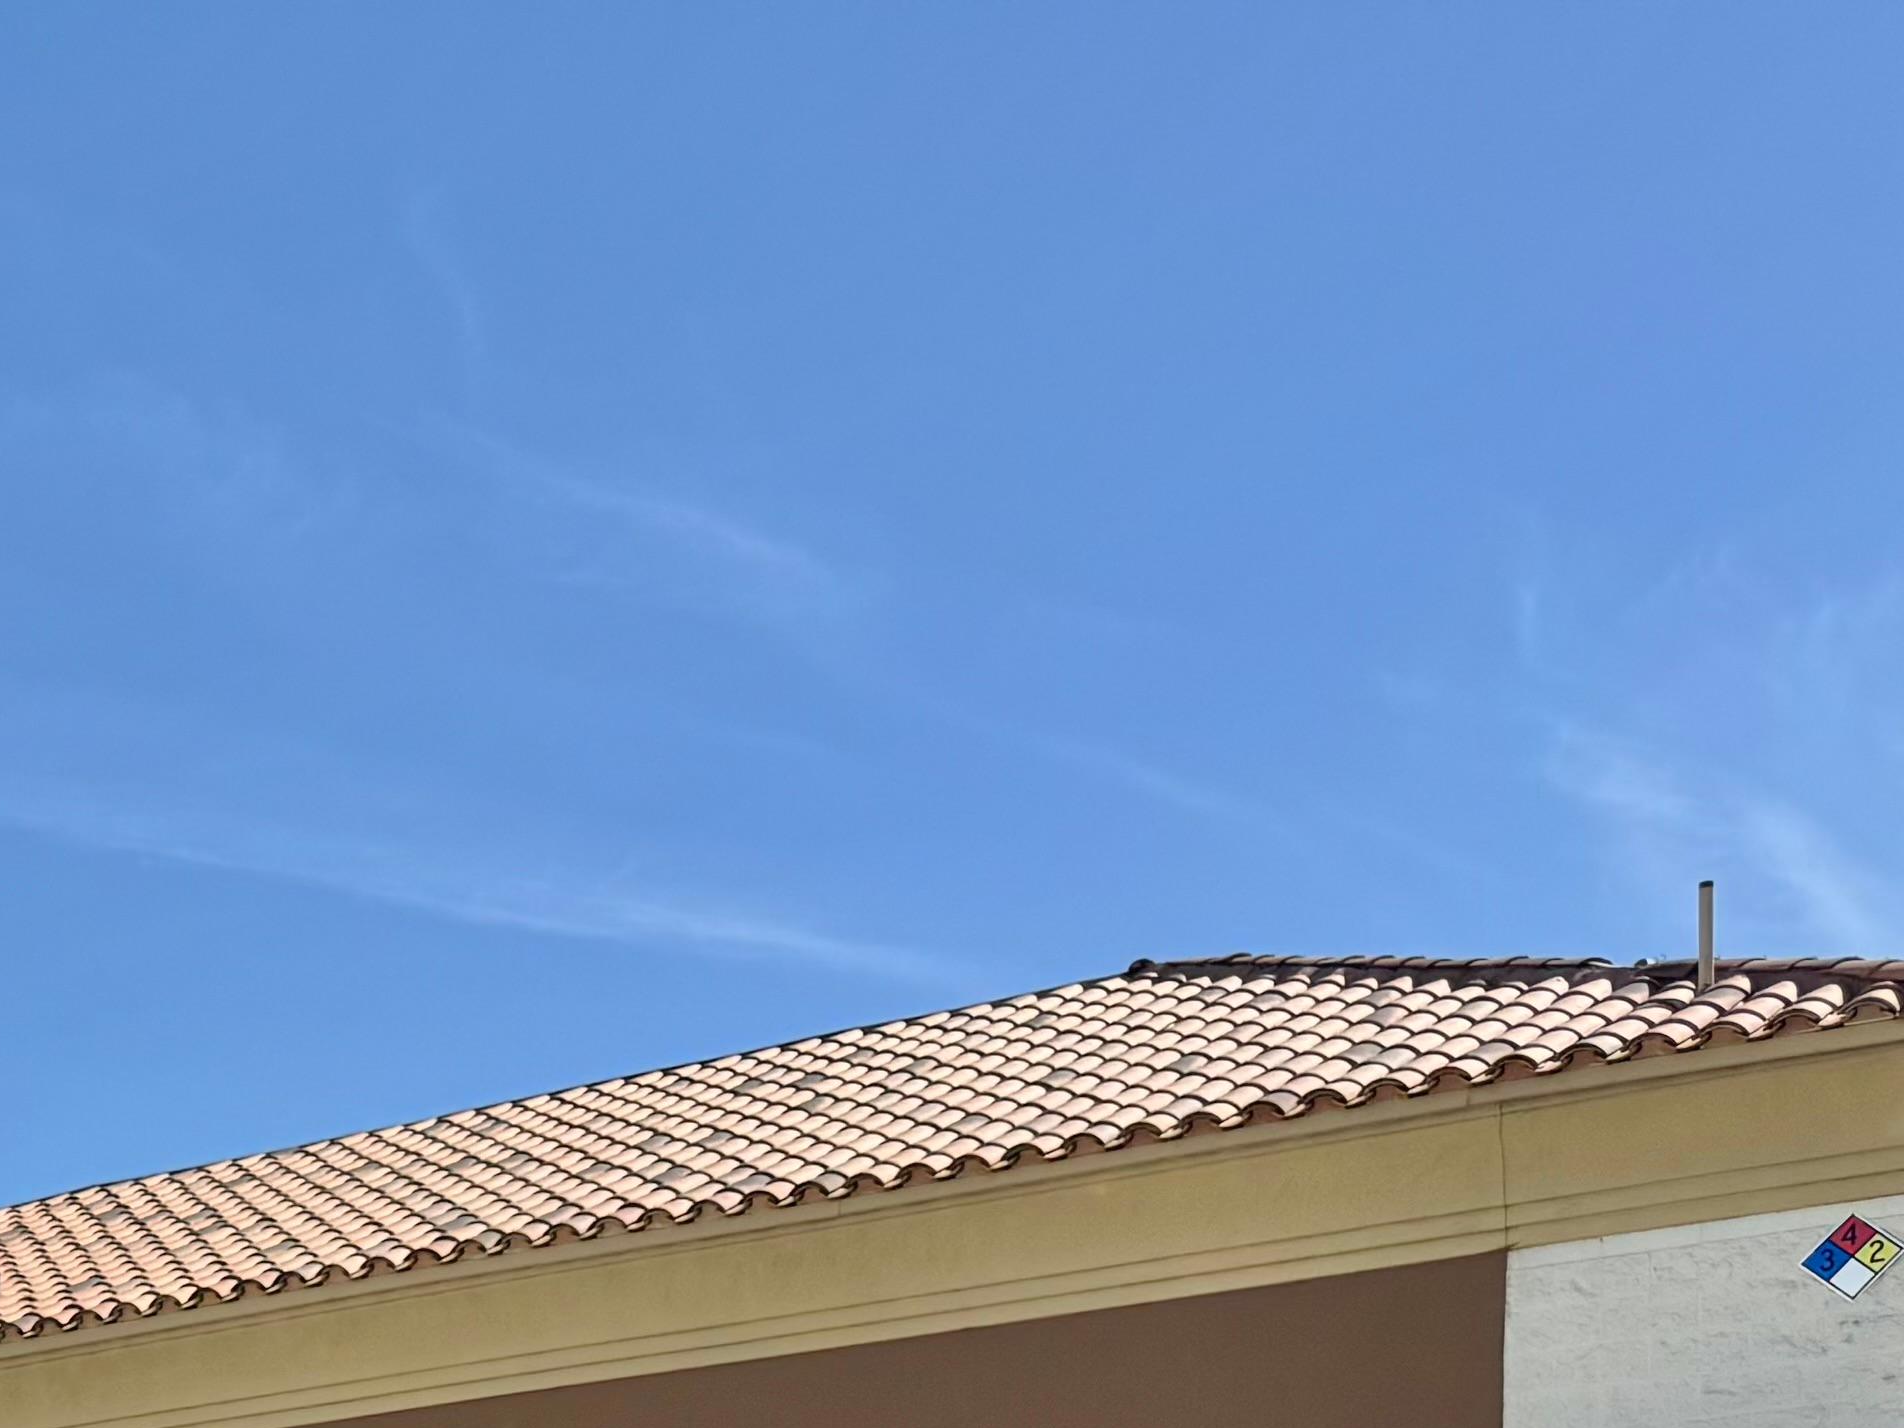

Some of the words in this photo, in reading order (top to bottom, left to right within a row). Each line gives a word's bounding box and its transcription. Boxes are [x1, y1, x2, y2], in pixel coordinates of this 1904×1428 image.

[1841, 1223, 1857, 1245] 4
[1820, 1248, 1835, 1271] 3
[1869, 1239, 1885, 1263] 2
